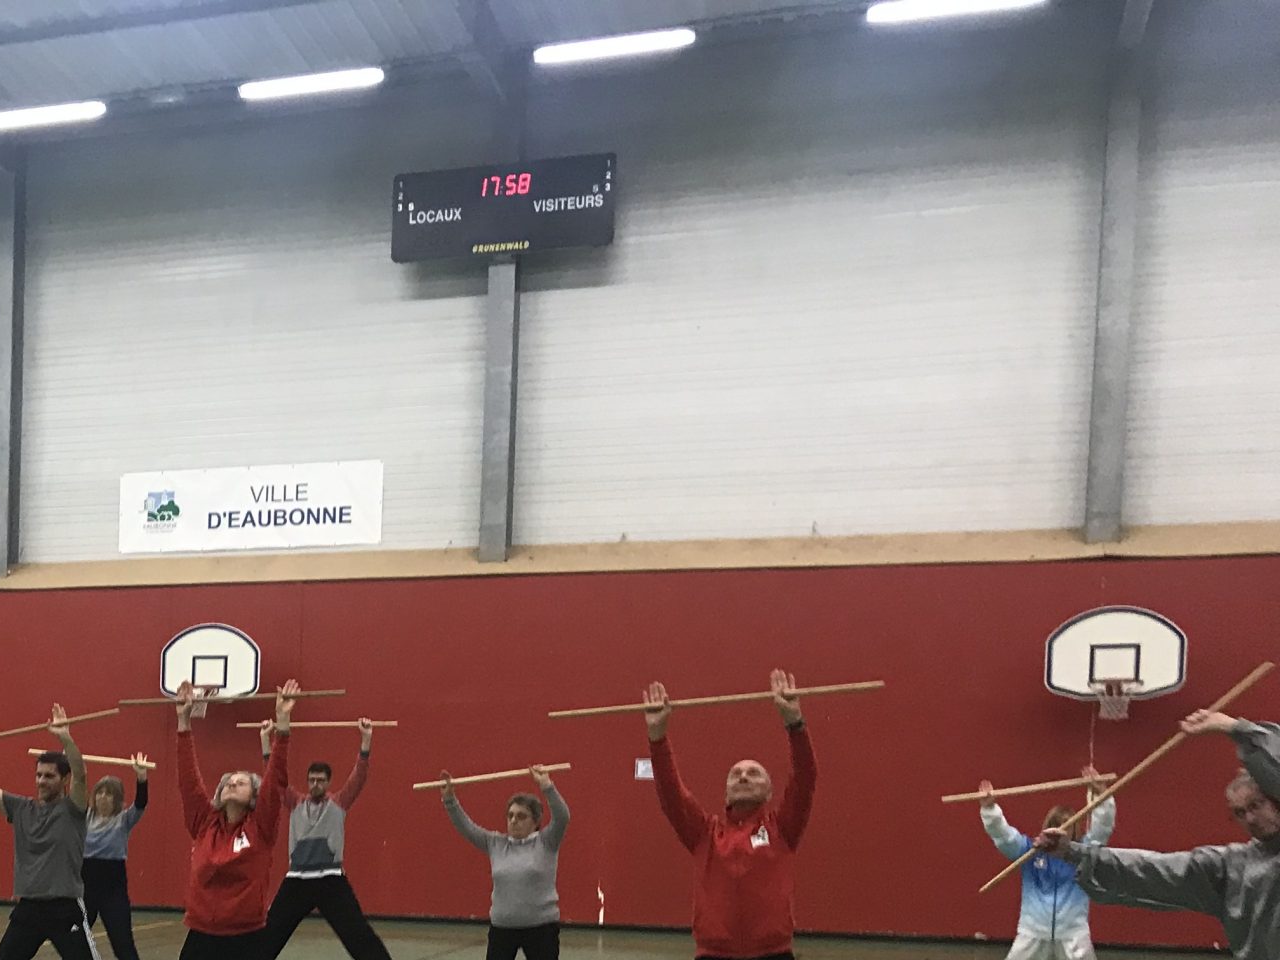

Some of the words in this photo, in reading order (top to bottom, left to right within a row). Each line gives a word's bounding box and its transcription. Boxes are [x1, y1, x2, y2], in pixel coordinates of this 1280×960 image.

[533, 194, 604, 213] VISITEURS
[408, 208, 462, 225] LOCAUX
[250, 483, 309, 503] VILLE
[207, 506, 353, 529] D'EAUBONNE
